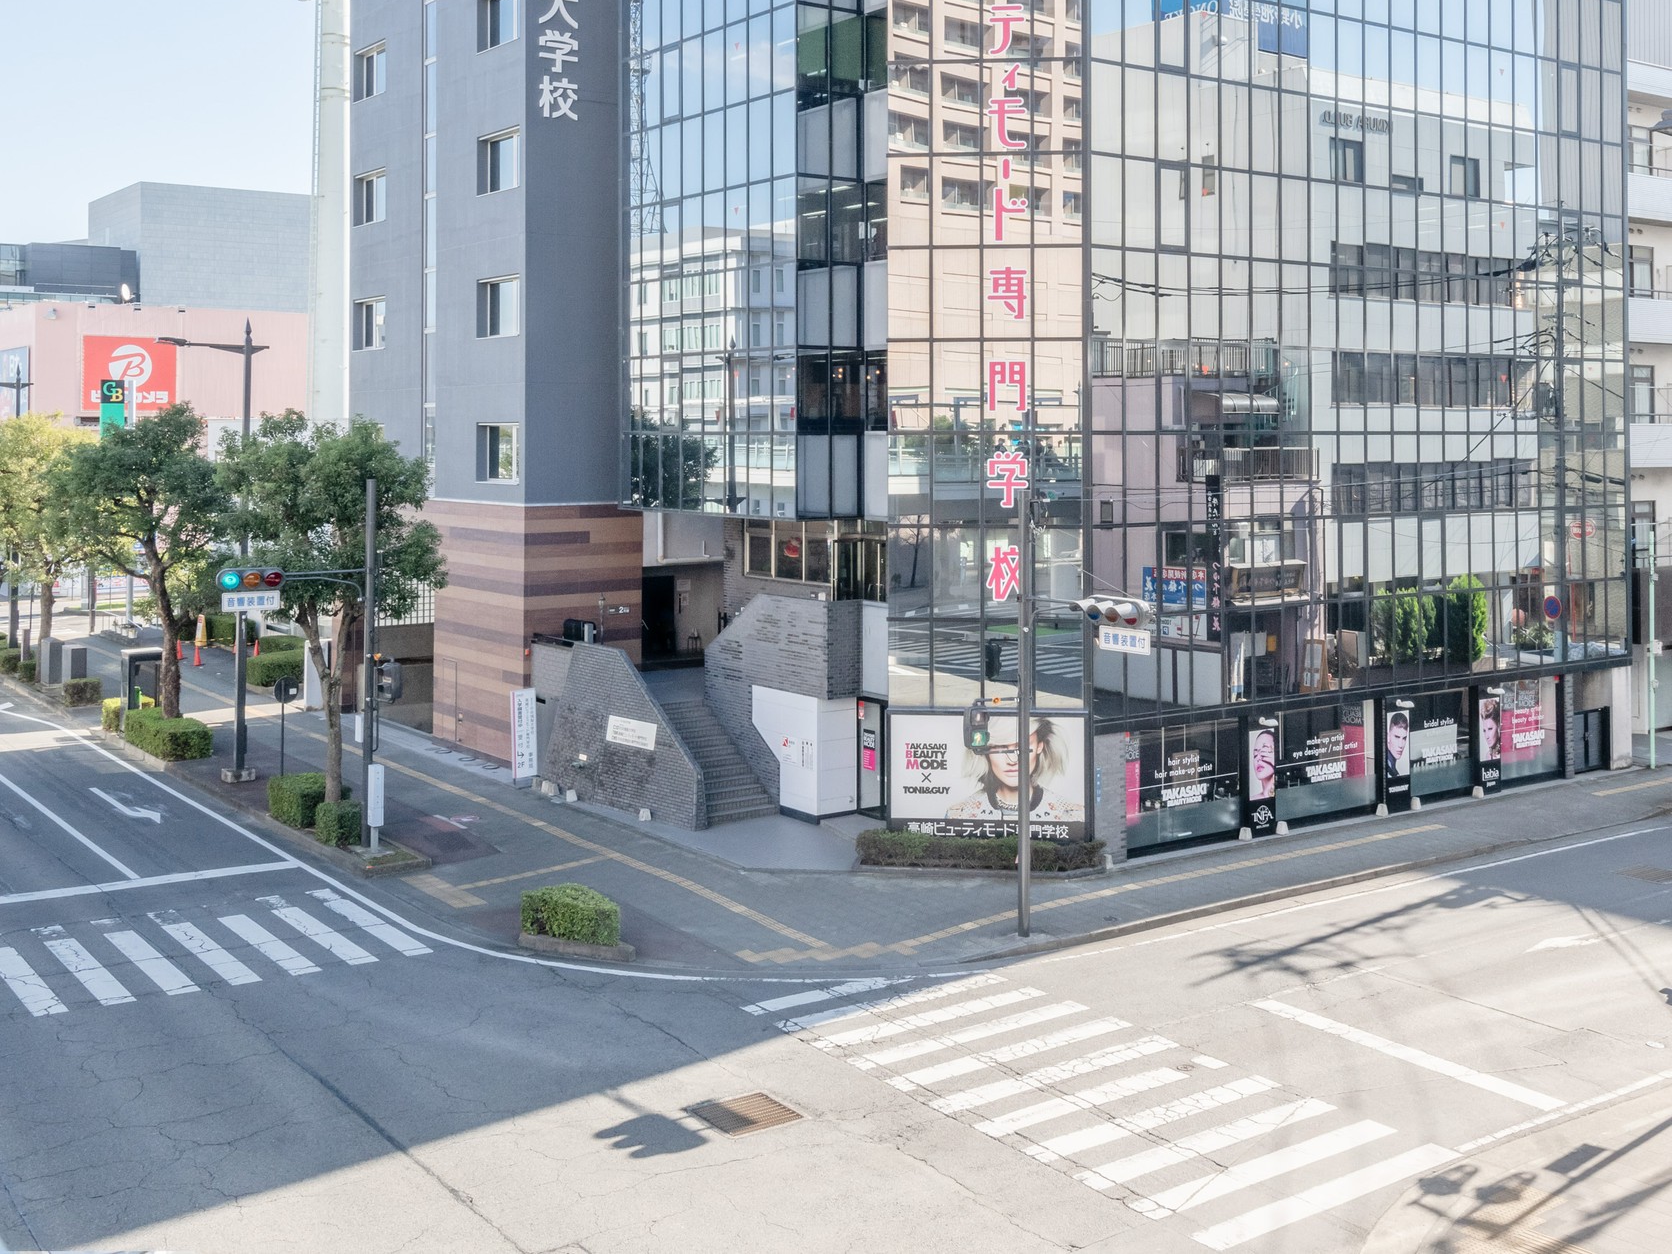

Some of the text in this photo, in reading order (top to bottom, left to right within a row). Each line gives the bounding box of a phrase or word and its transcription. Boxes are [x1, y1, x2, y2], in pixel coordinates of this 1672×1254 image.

[1103, 632, 1146, 649] 音響装置付
[1423, 718, 1439, 728] bridal
[1306, 734, 1345, 746] make-up artist
[1512, 729, 1545, 744] TAKASAKI
[905, 742, 948, 750] TAKASAKI
[1292, 751, 1303, 759] eye
[1304, 747, 1327, 757] designer
[1344, 741, 1358, 749] artist
[1421, 743, 1458, 759] TAKASAKI
[905, 750, 947, 759] BEAUTY
[1167, 754, 1200, 766] hair stylist
[906, 759, 948, 771] MODE
[1154, 763, 1213, 779] hair make-up artist
[1306, 760, 1347, 777] TAKASAKI
[1482, 767, 1499, 781] habia
[903, 786, 951, 795] TONI&GUY
[1161, 783, 1207, 802] TAKASAKI
[907, 821, 1069, 839] 高崎ビューティモード門学校
